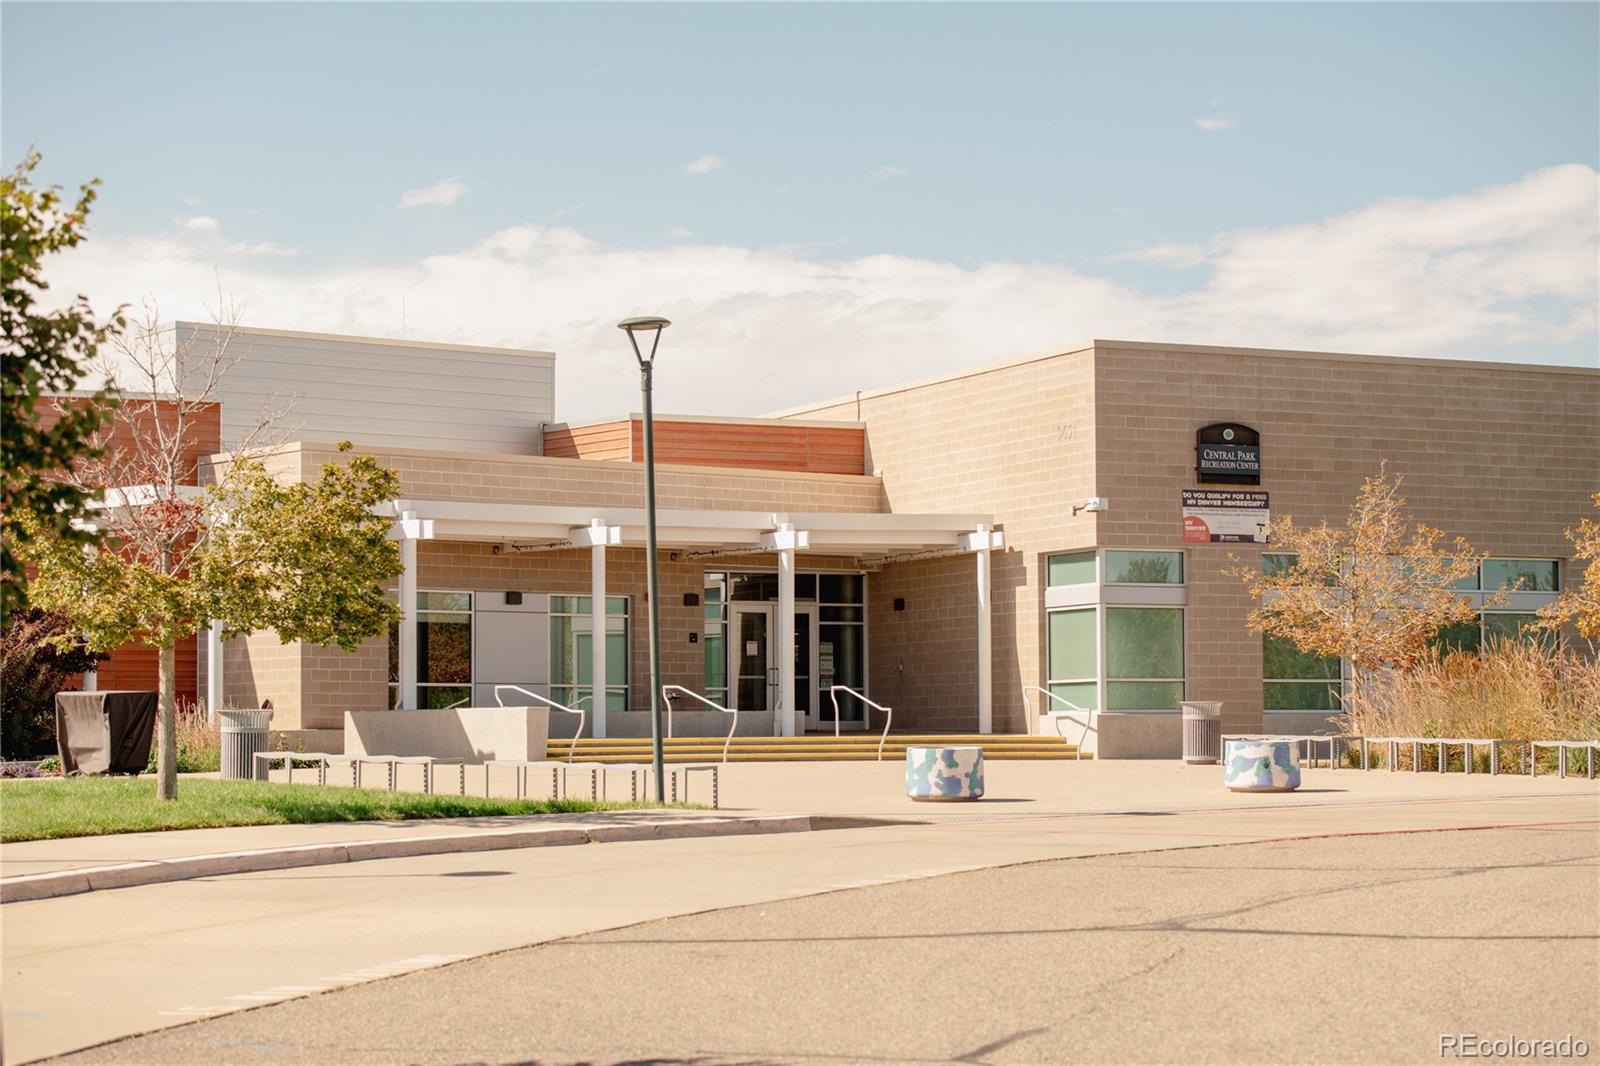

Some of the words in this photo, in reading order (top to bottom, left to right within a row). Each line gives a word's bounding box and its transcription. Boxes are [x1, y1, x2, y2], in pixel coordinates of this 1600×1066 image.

[1203, 449, 1236, 460] CENTRAL
[1237, 450, 1256, 461] PARK
[1201, 460, 1236, 469] RECREATION
[1236, 461, 1259, 470] CENTER
